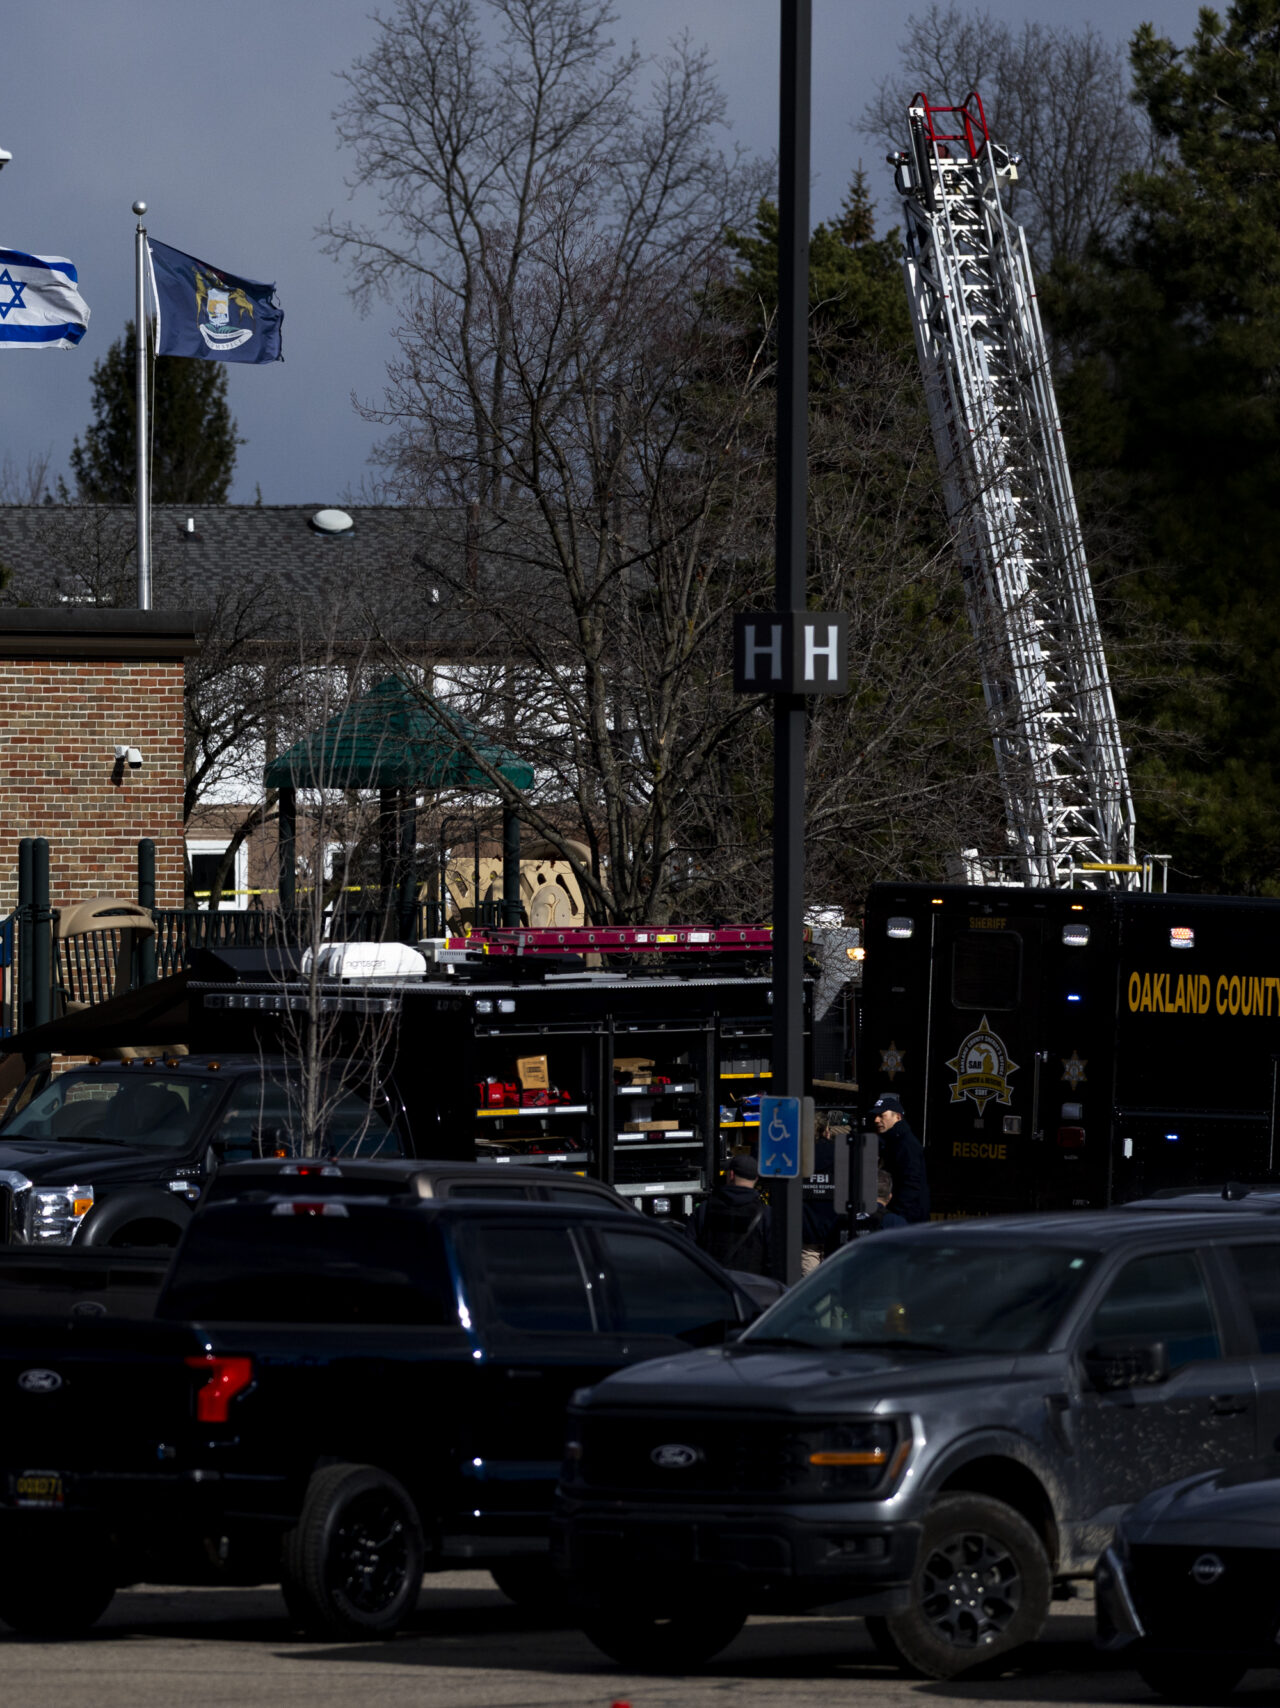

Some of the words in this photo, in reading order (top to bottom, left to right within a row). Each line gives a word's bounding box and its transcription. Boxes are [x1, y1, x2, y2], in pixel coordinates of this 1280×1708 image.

[744, 624, 782, 680] H
[804, 625, 838, 680] H
[969, 916, 1007, 929] SHERIFF
[1128, 971, 1211, 1014] OAKLAND
[952, 1141, 1007, 1160] RESCUE
[810, 1174, 829, 1183] FBI
